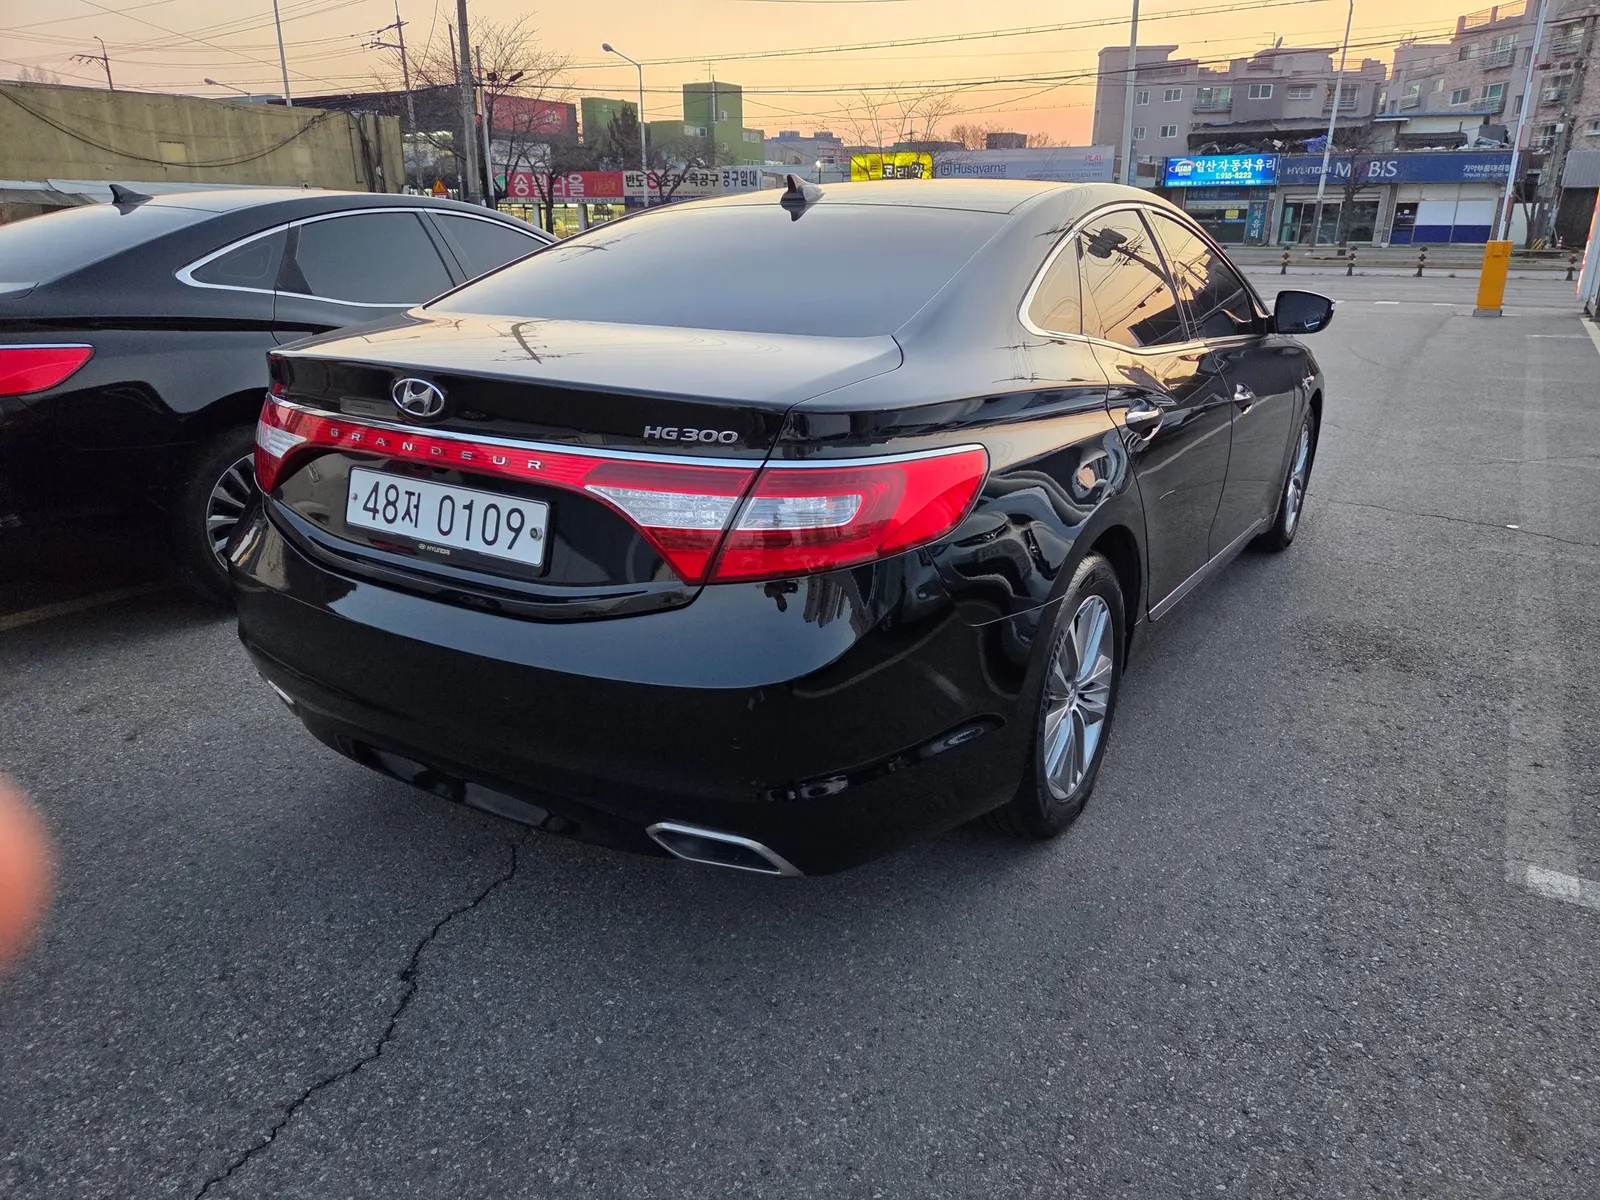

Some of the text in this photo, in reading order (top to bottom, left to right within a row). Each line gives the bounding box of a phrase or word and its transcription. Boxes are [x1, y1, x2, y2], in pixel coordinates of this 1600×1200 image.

[953, 163, 1007, 175] Husqvarna
[1195, 157, 1276, 173] 일산자동차유리
[1287, 166, 1332, 175] HYUNDI
[625, 174, 644, 187] 반도
[723, 170, 757, 187] 공구임대
[643, 425, 739, 444] HG300
[330, 427, 542, 470] GRANDEUR
[362, 481, 526, 550] 48저 0109
